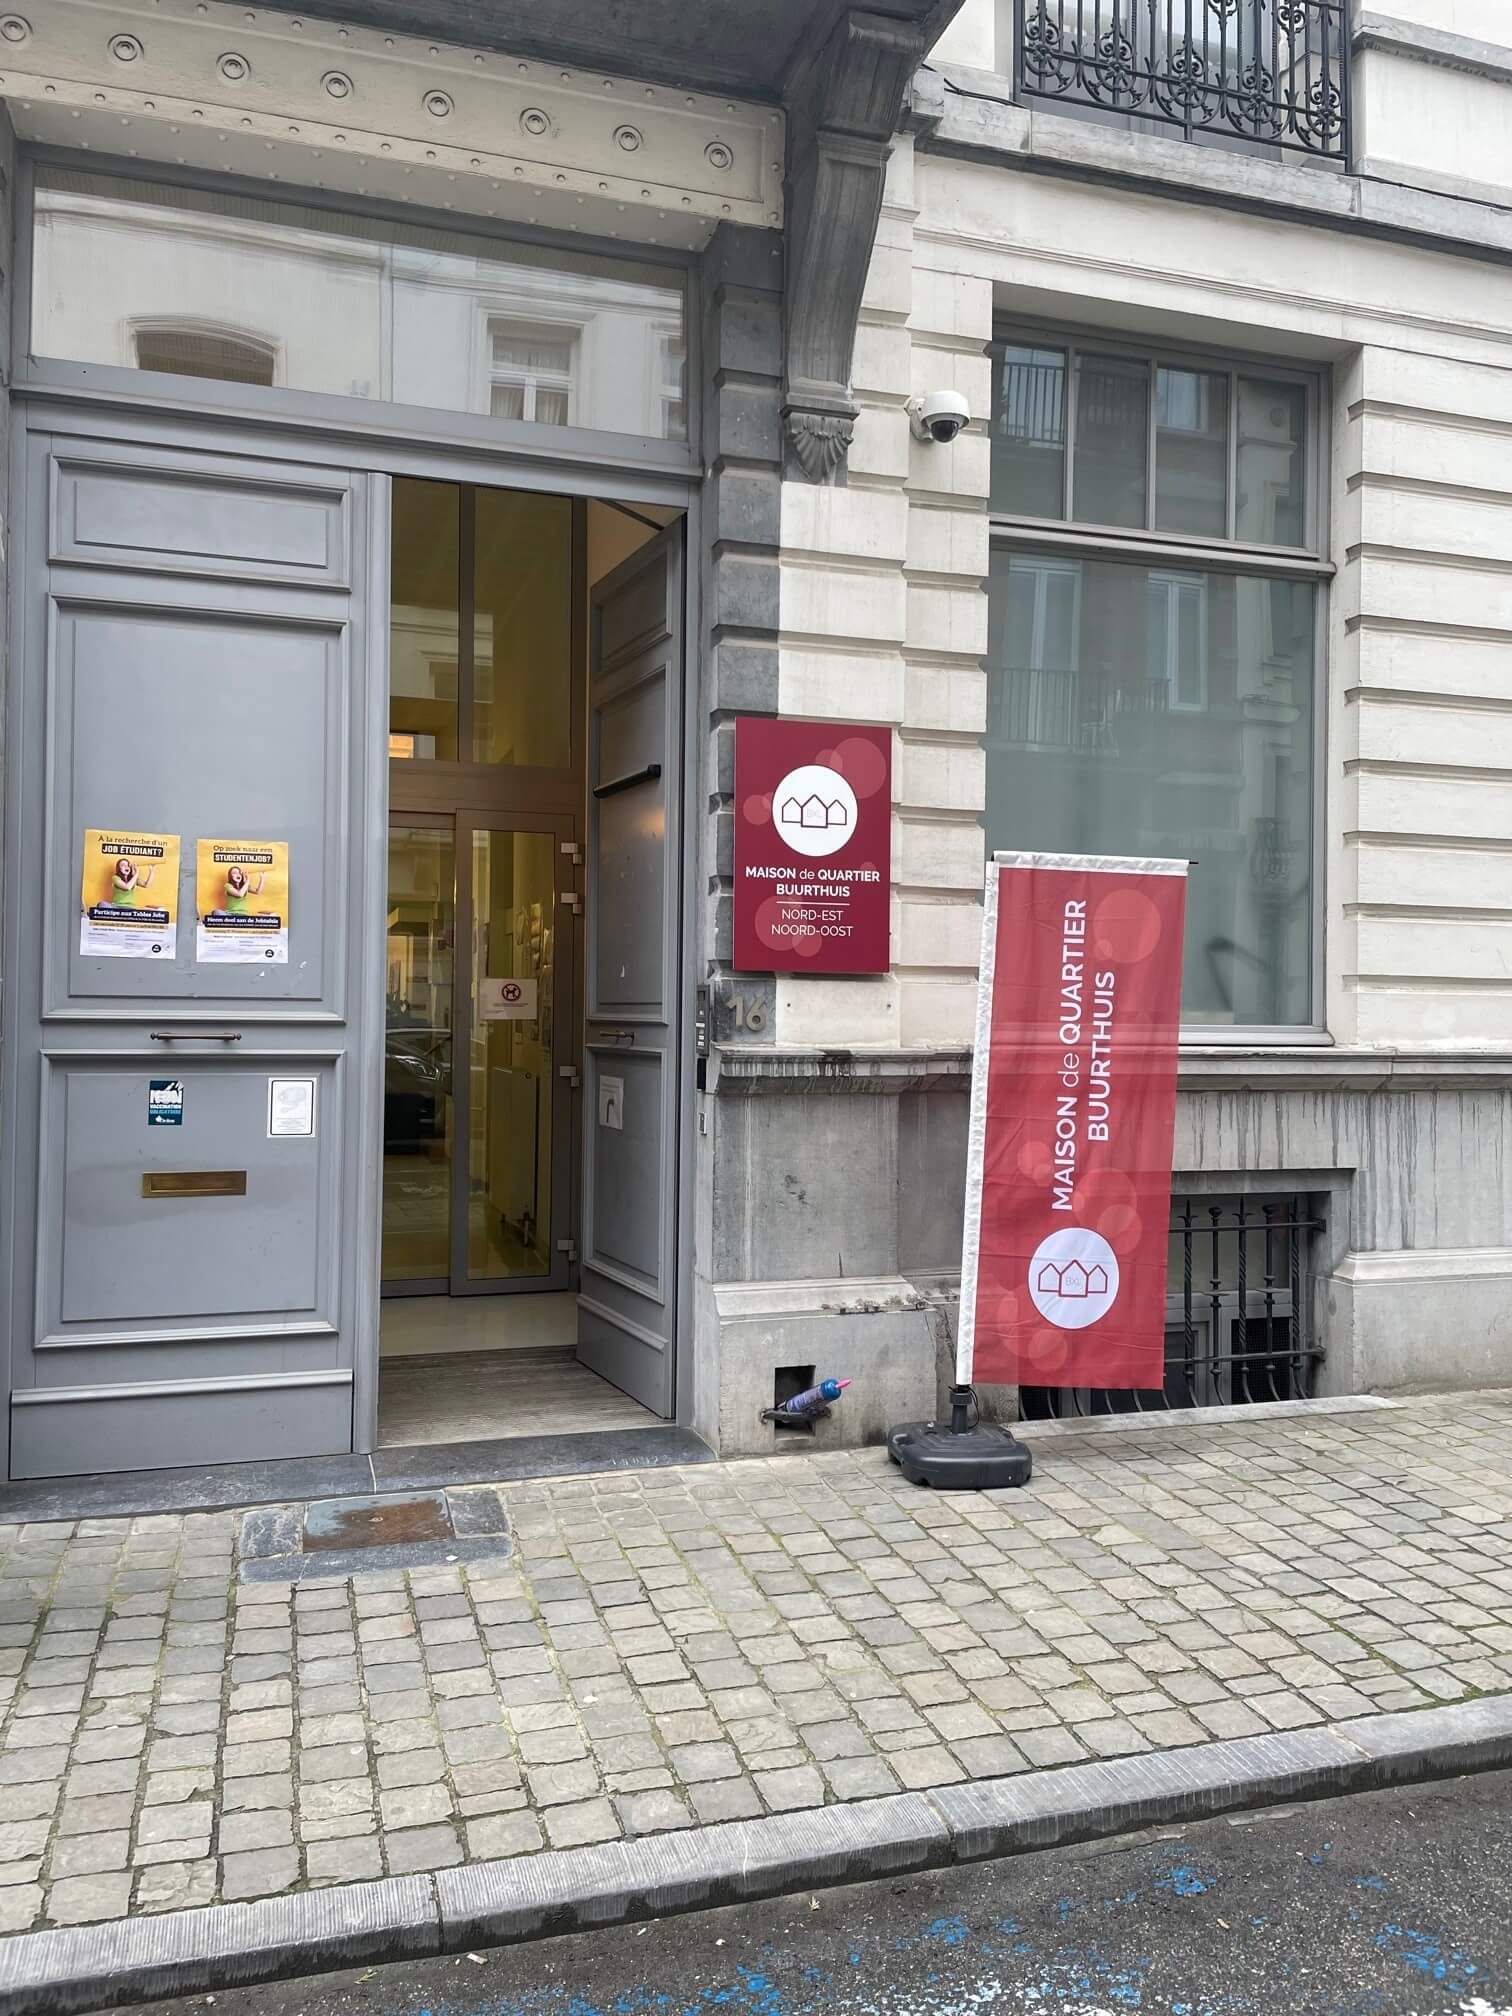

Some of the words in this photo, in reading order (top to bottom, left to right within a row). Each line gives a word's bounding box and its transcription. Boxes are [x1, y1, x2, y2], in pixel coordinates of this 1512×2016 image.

[115, 837, 150, 845] recherche
[102, 845, 119, 853] JOB
[214, 853, 272, 863] STUDENTENJOB?
[745, 866, 796, 879] MAISON
[799, 868, 815, 880] de
[818, 869, 880, 882] QUARTIER
[776, 883, 850, 897] BUURTHUIS
[94, 909, 120, 917] Participe
[781, 909, 844, 921] NORD-EST
[771, 924, 854, 936] NOORD-OOST
[1059, 900, 1087, 1045] QUARTIER
[726, 992, 768, 1031] 16
[1087, 971, 1115, 1141] BUURTHUIS
[1057, 1052, 1080, 1088] de
[1051, 1096, 1078, 1211] MAISON
